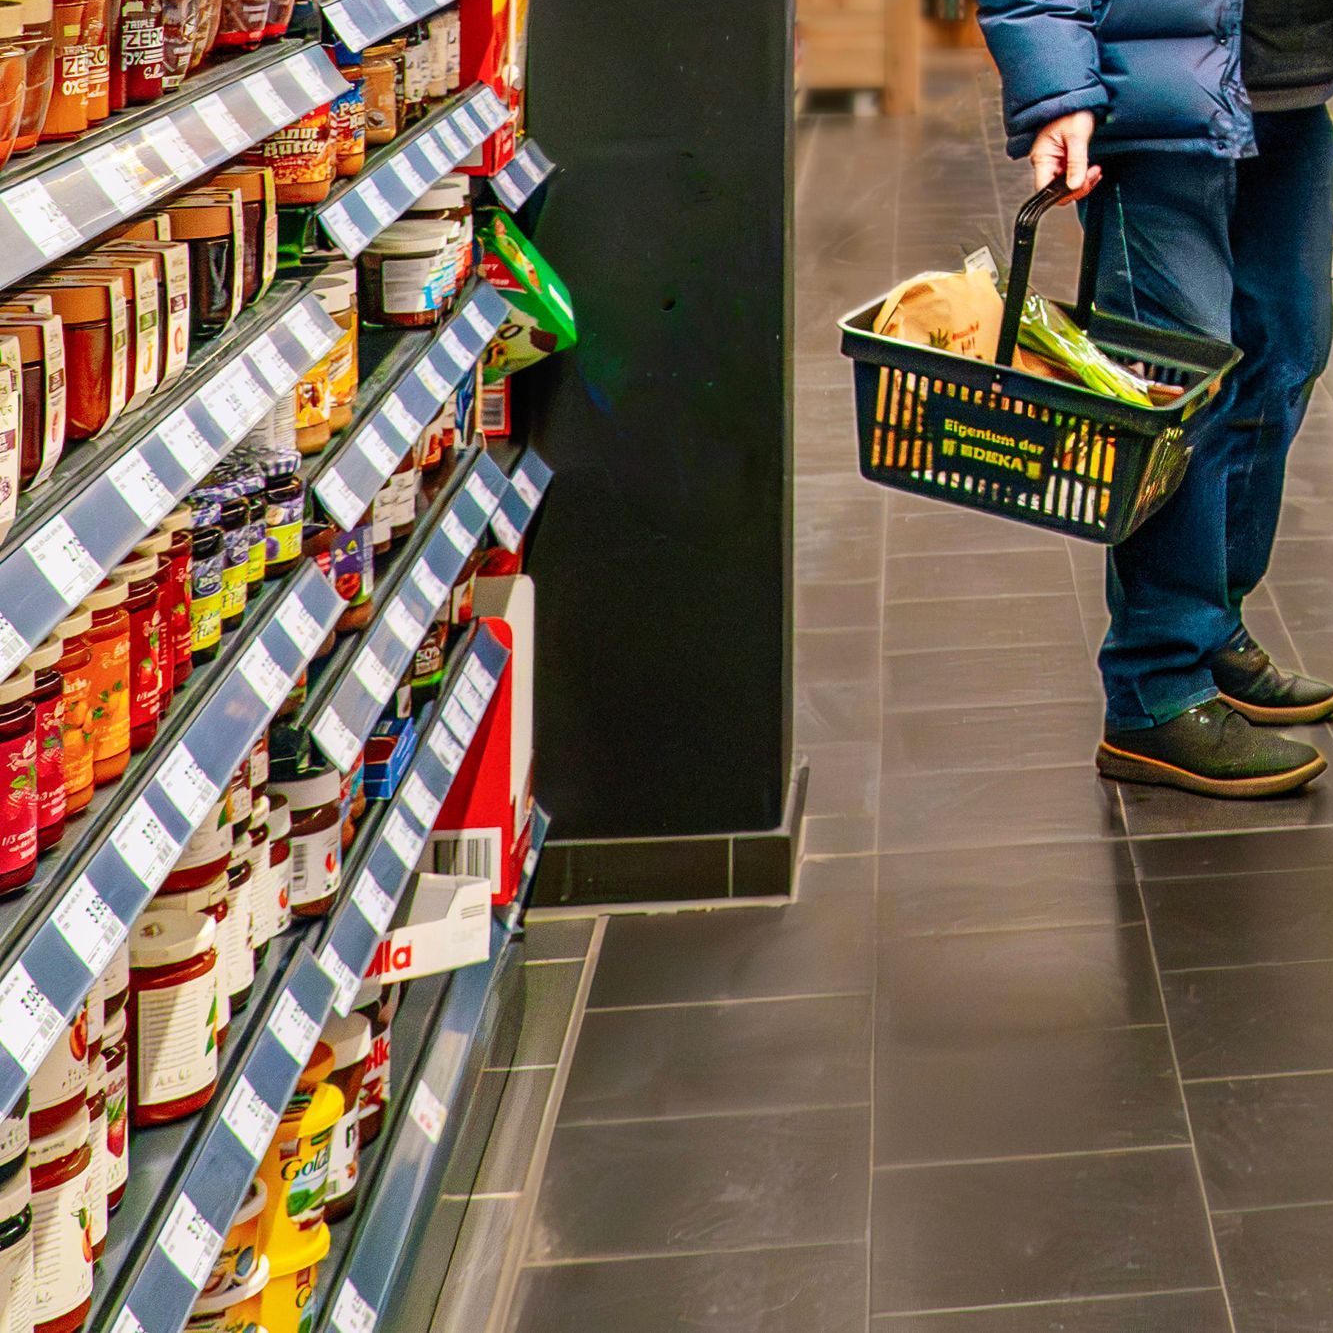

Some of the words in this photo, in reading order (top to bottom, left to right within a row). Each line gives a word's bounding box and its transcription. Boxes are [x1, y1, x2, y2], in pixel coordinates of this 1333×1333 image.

[126, 28, 163, 49] ZERO
[943, 417, 1017, 449] Eigentum
[1018, 437, 1046, 454] der
